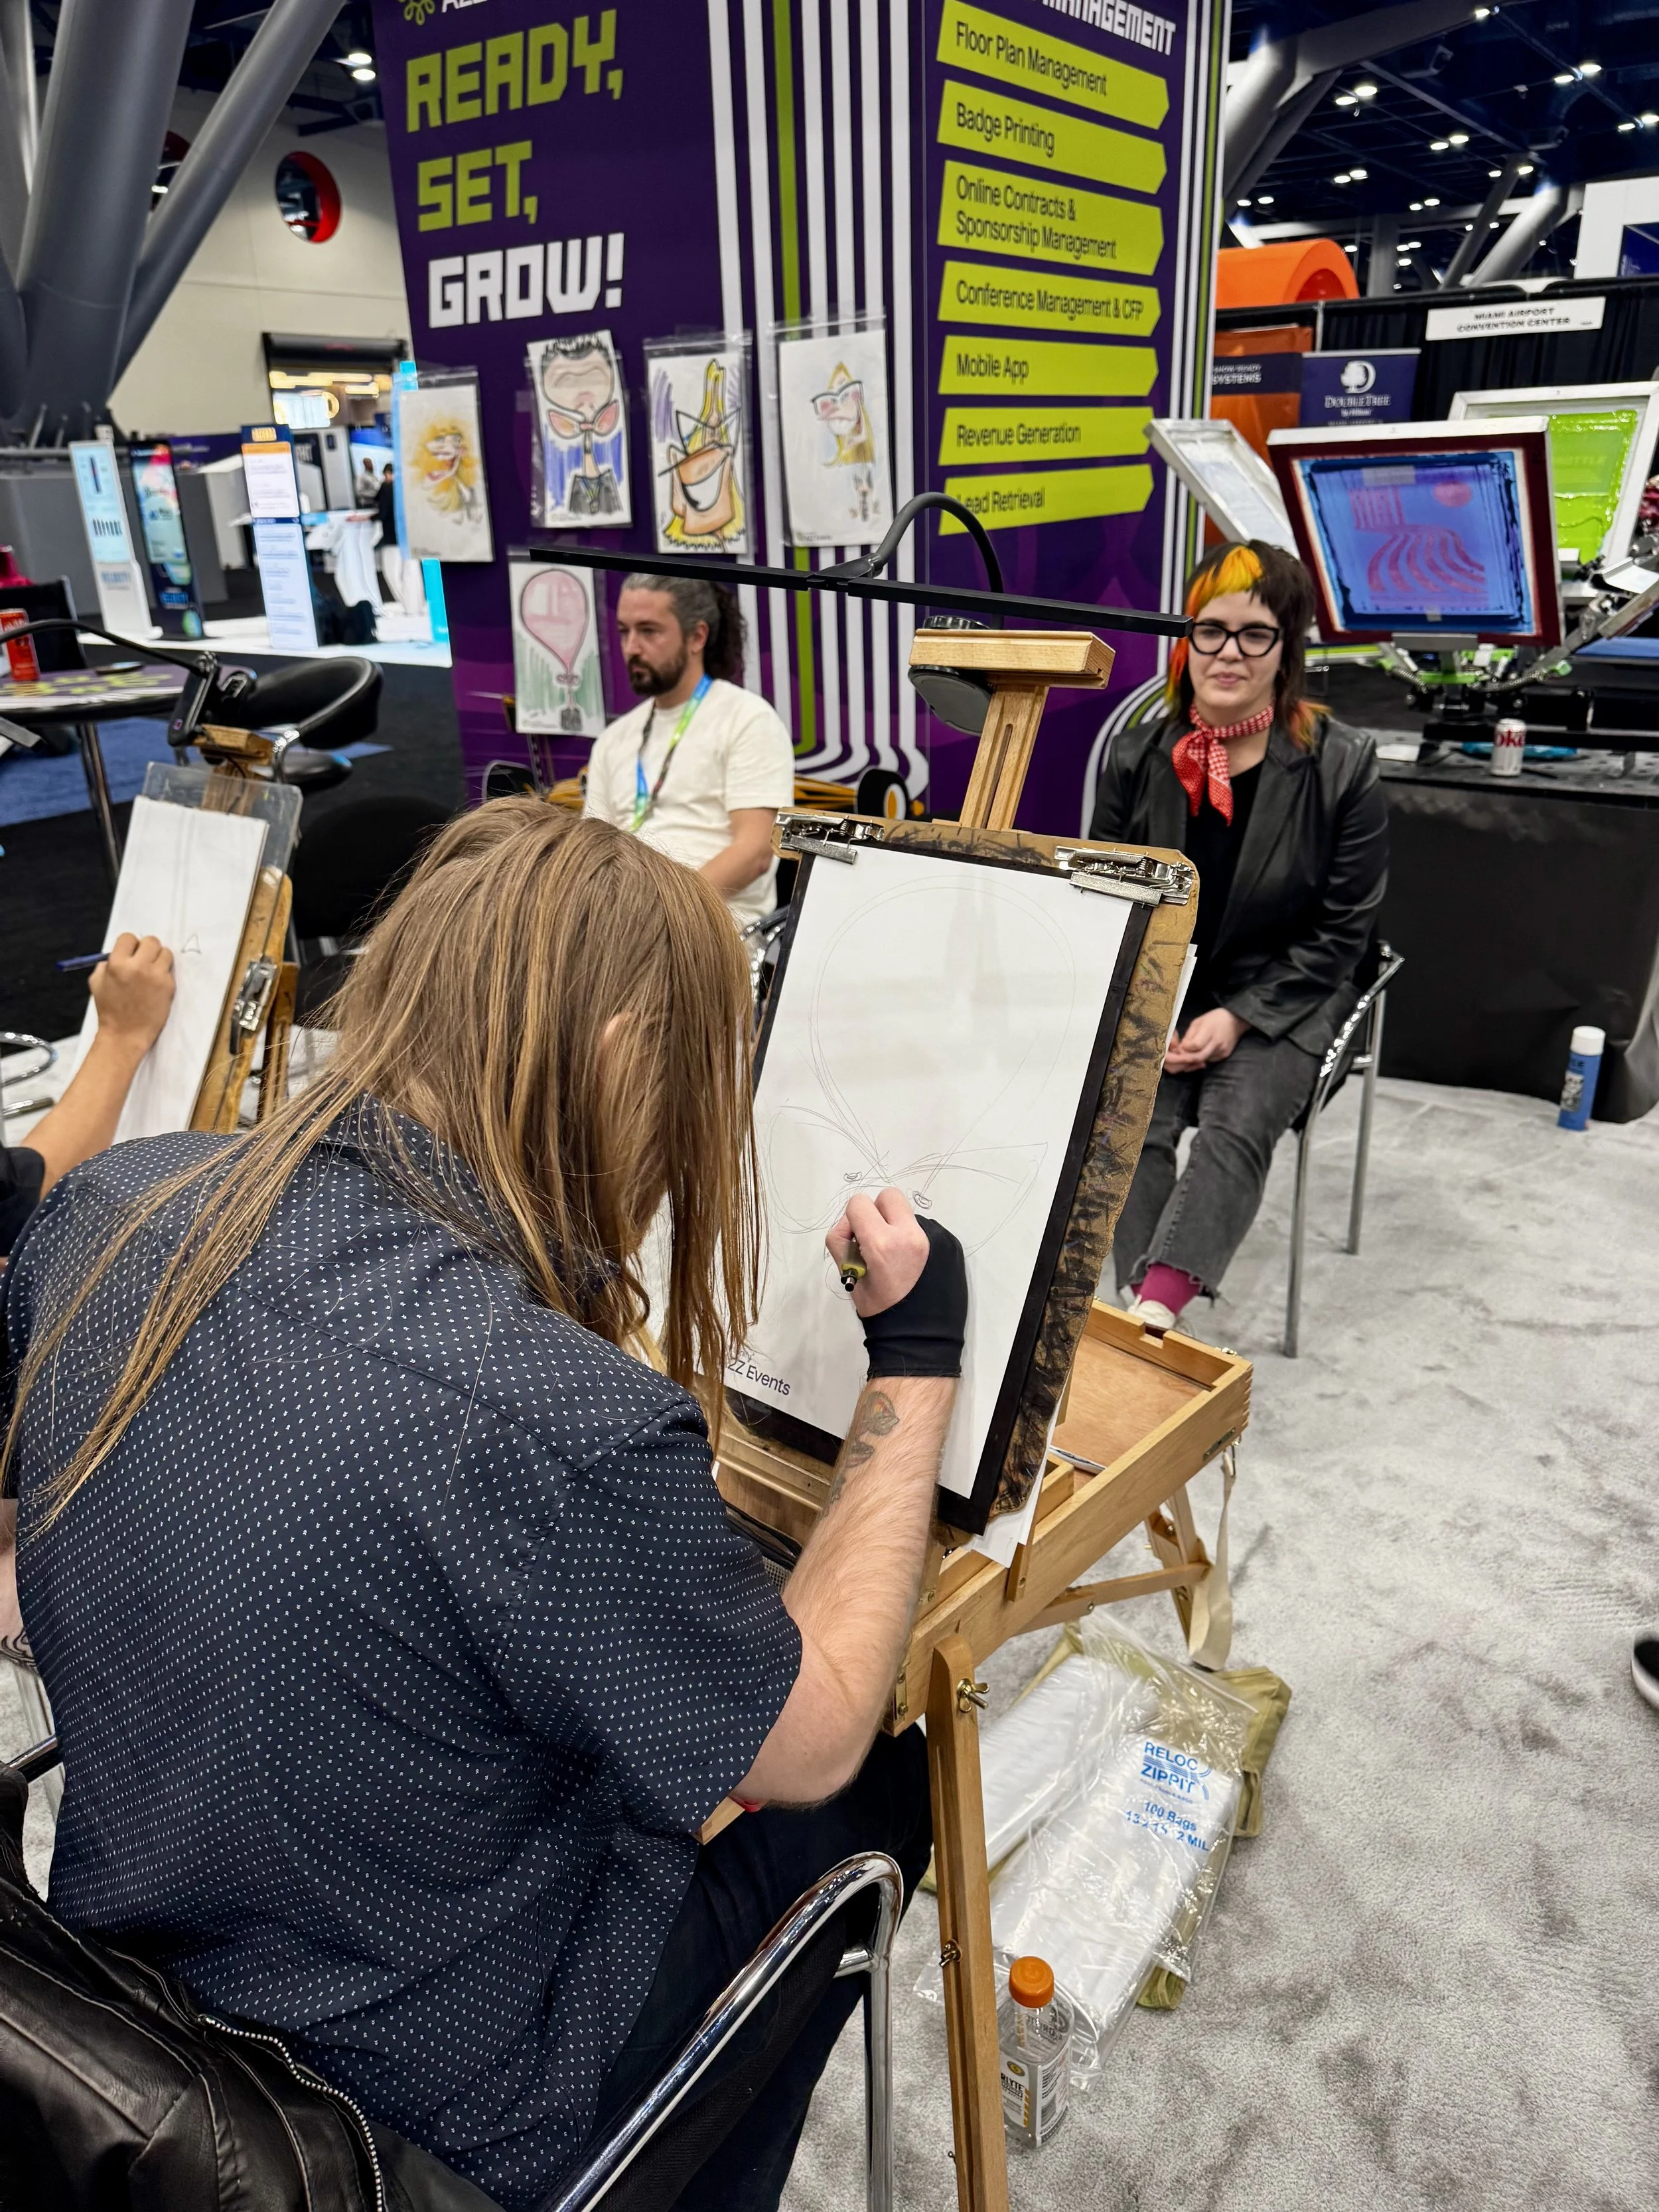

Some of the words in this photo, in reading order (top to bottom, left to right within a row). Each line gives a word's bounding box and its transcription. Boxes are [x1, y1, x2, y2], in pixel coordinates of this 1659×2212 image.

[406, 9, 624, 133] READY,
[956, 21, 993, 56] Floor
[997, 35, 1025, 67] Plan
[1028, 46, 1108, 96] Management
[956, 102, 1001, 142] Badge
[1005, 115, 1054, 157] Printing
[417, 140, 538, 232] SET,
[956, 175, 1001, 206] Online
[1003, 184, 1066, 219] Contracts
[1067, 198, 1076, 220] &
[956, 210, 1040, 253] Sponsorship
[1042, 227, 1117, 260] Management
[428, 232, 624, 329] GROW!
[956, 280, 1034, 311] Conference
[1037, 290, 1112, 321] Management
[1113, 299, 1119, 318] &
[1122, 299, 1143, 321] CFP
[1475, 311, 1506, 321] MIAMI
[1508, 308, 1555, 319] AIRPORT
[1457, 320, 1525, 332] CONVENTION
[1527, 317, 1571, 327] CENTER
[956, 353, 1001, 378] Mobile
[1003, 357, 1029, 385] App
[956, 424, 1014, 447] Revenue
[1017, 422, 1081, 445] Generation
[991, 486, 1046, 513] Retrieval
[747, 1364, 791, 1396] Events
[1144, 1741, 1198, 1771] RELOC
[1140, 1763, 1196, 1793] ZIPPIT
[1144, 1801, 1165, 1818] 100
[1167, 1811, 1197, 1832] Bags
[1187, 1834, 1210, 1852] MIL
